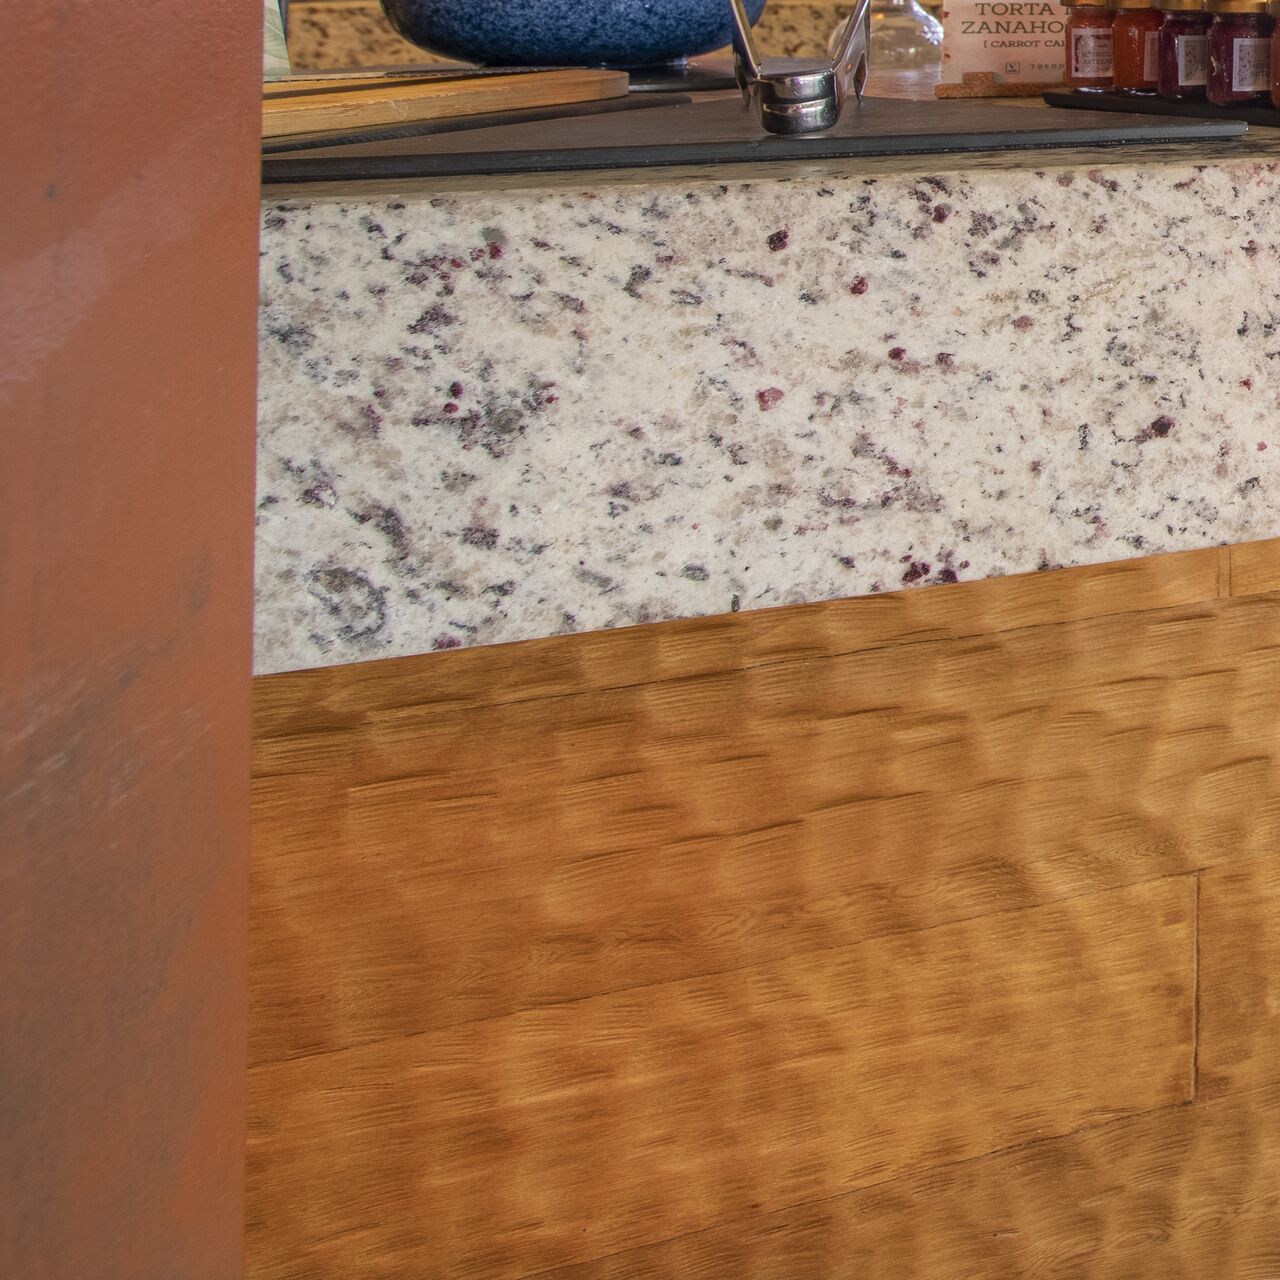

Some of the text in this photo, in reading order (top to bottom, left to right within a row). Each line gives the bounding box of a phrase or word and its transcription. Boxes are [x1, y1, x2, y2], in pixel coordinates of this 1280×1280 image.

[975, 2, 1055, 16] TORTA
[961, 20, 1064, 34] ZANAHO
[990, 40, 1041, 48] CARROT
